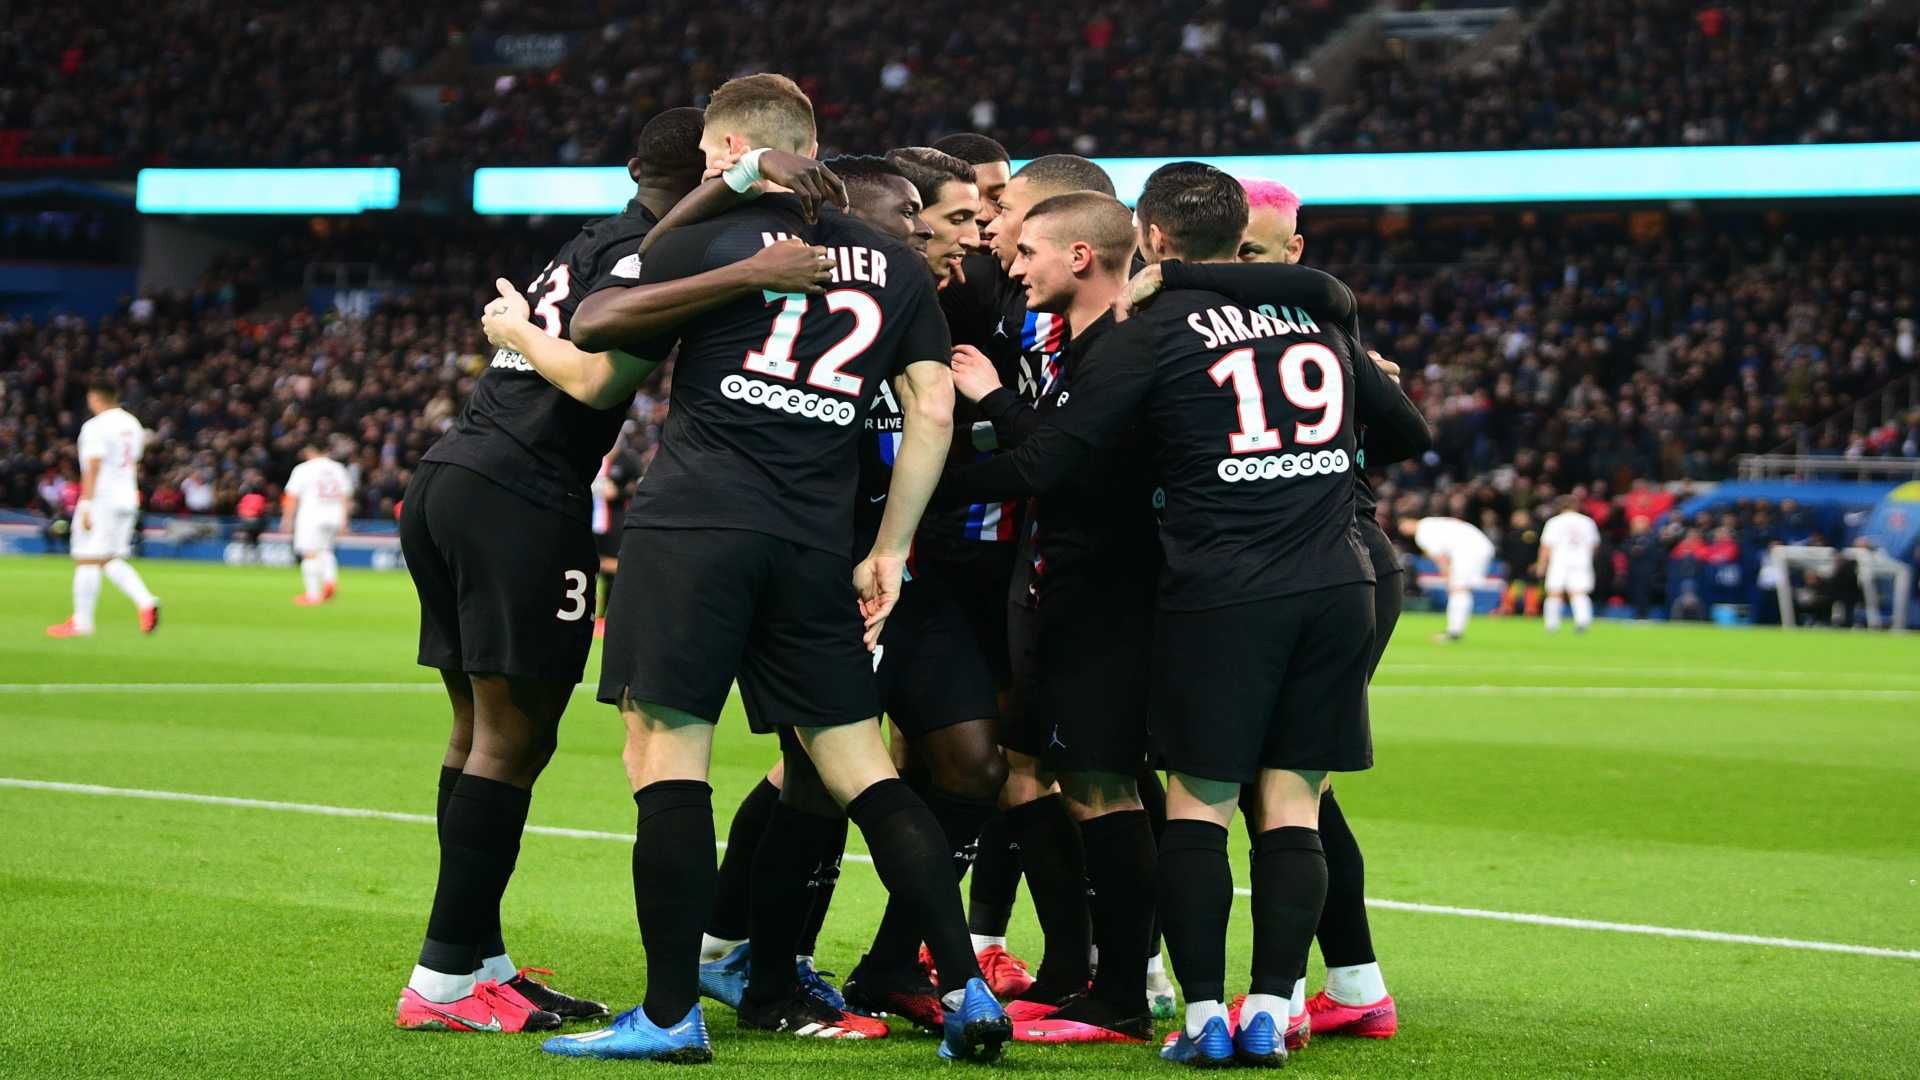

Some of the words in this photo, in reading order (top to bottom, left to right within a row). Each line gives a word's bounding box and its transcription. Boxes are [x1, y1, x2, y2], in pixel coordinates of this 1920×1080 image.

[742, 288, 882, 398] 12
[1187, 304, 1320, 348] SARABIA
[720, 375, 855, 426] ooredoo
[877, 418, 902, 429] LIVE
[1207, 342, 1344, 454] 19
[1219, 450, 1349, 482] ooredoo
[556, 569, 597, 621] 3
